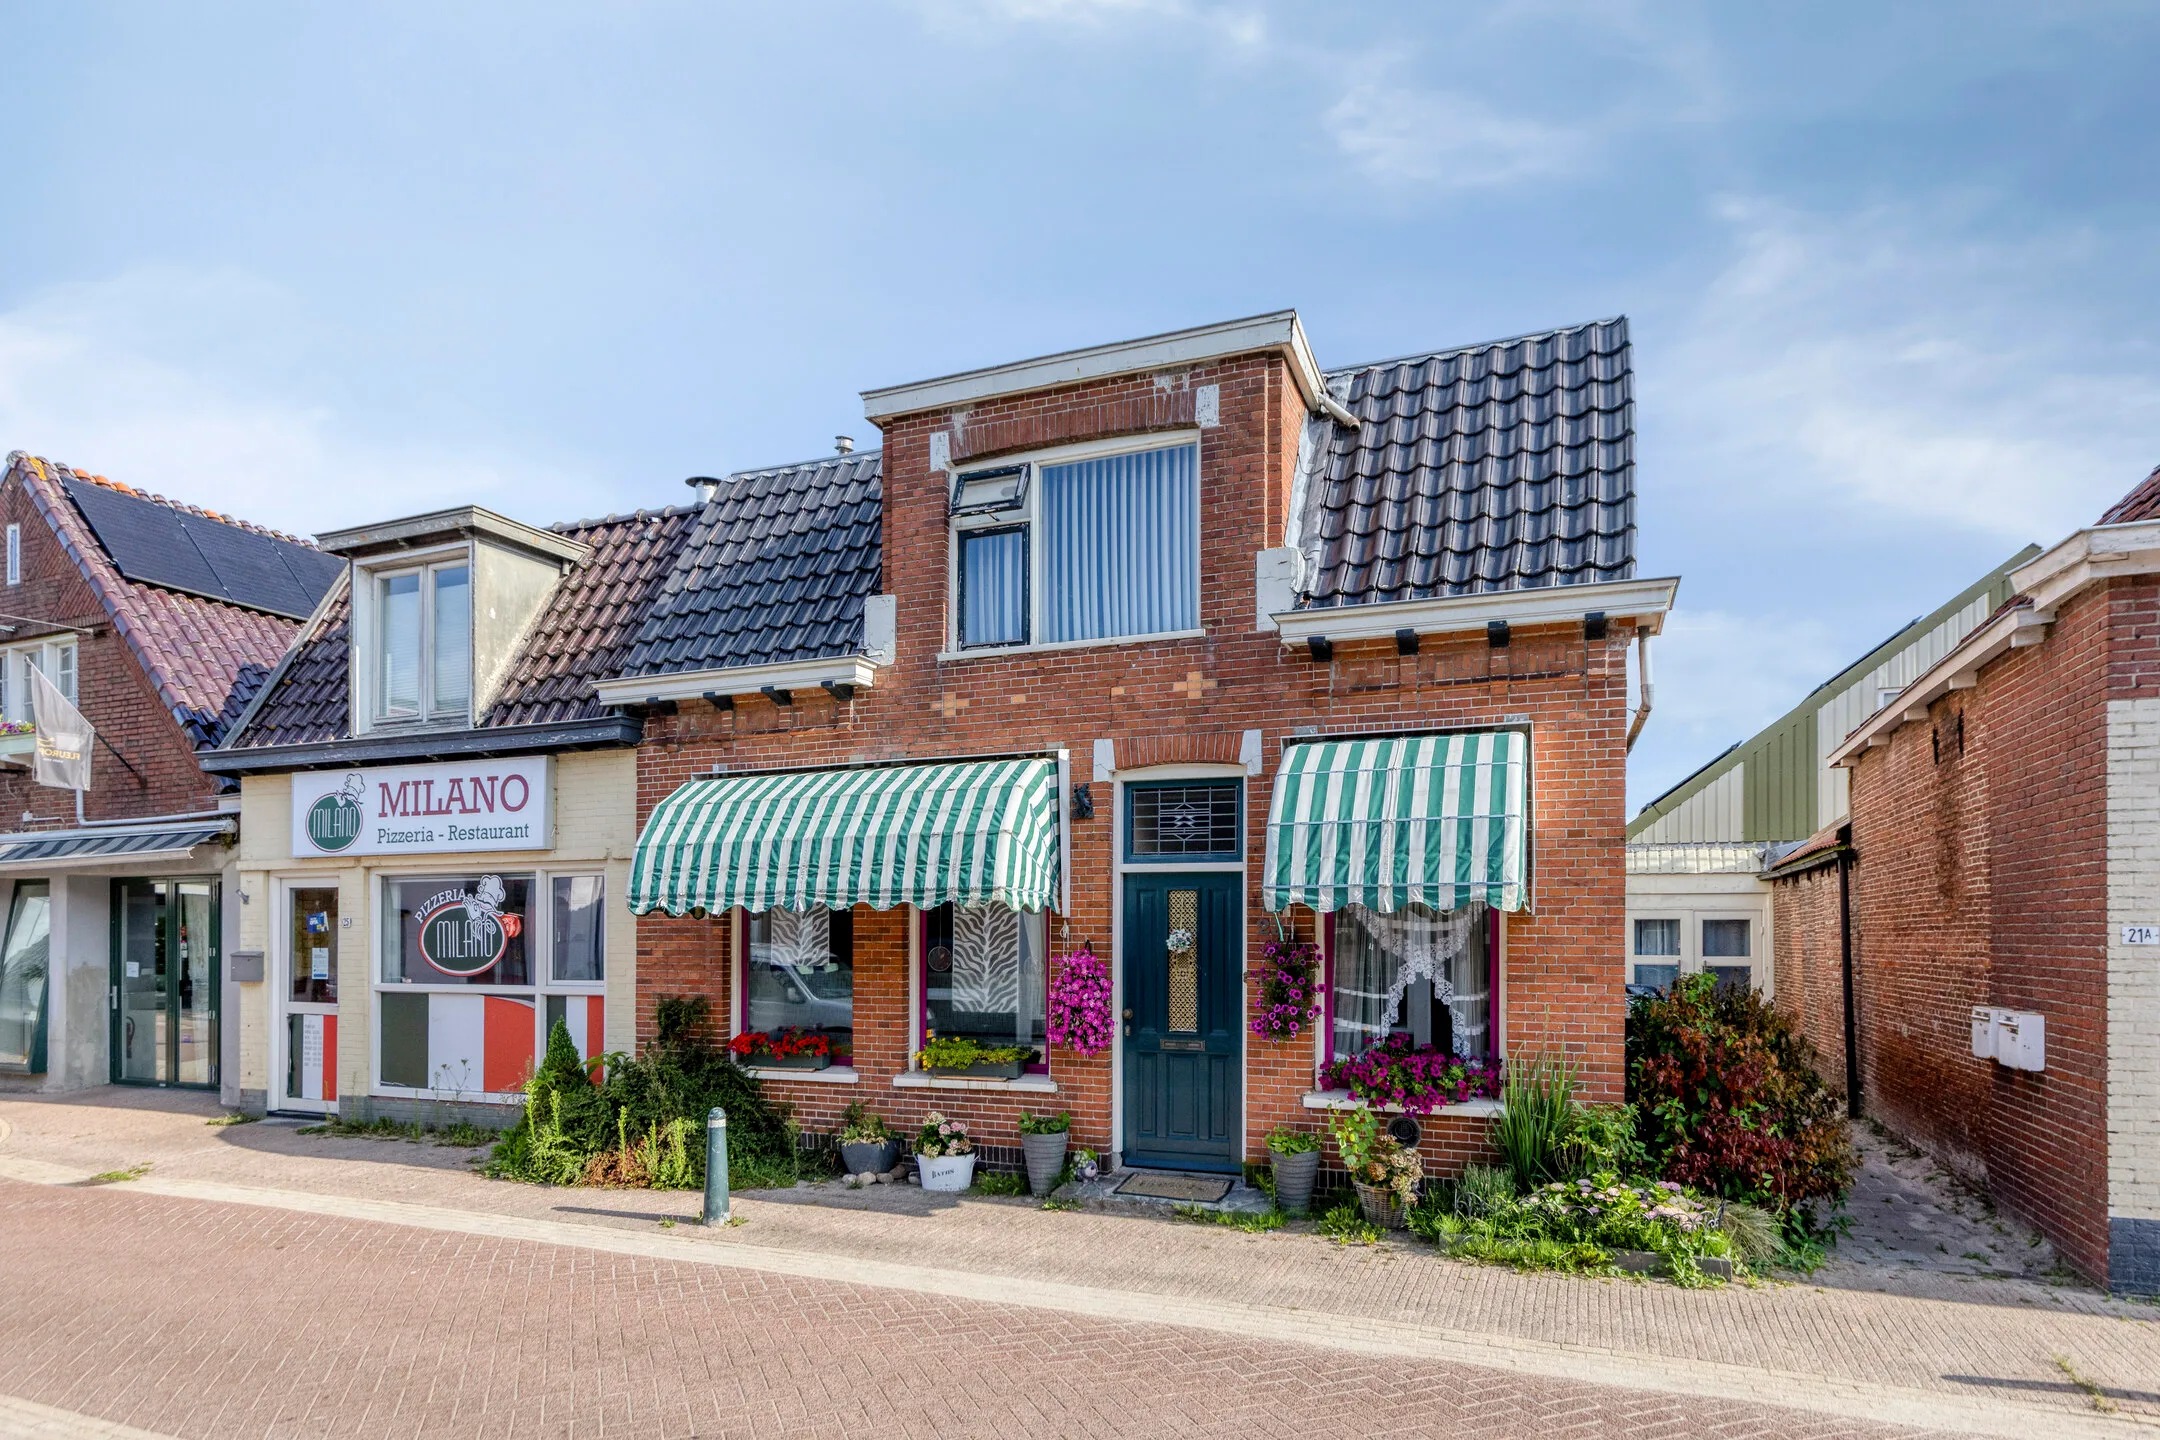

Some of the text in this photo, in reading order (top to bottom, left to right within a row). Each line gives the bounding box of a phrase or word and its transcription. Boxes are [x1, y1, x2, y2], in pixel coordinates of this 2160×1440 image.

[378, 774, 529, 818] MILANO
[313, 806, 356, 839] MILANO
[377, 826, 434, 844] Pizzeria
[448, 823, 529, 841] Restaurant
[415, 888, 466, 924] PIZZERIA
[437, 919, 493, 958] MILANO
[2128, 928, 2152, 943] 21A
